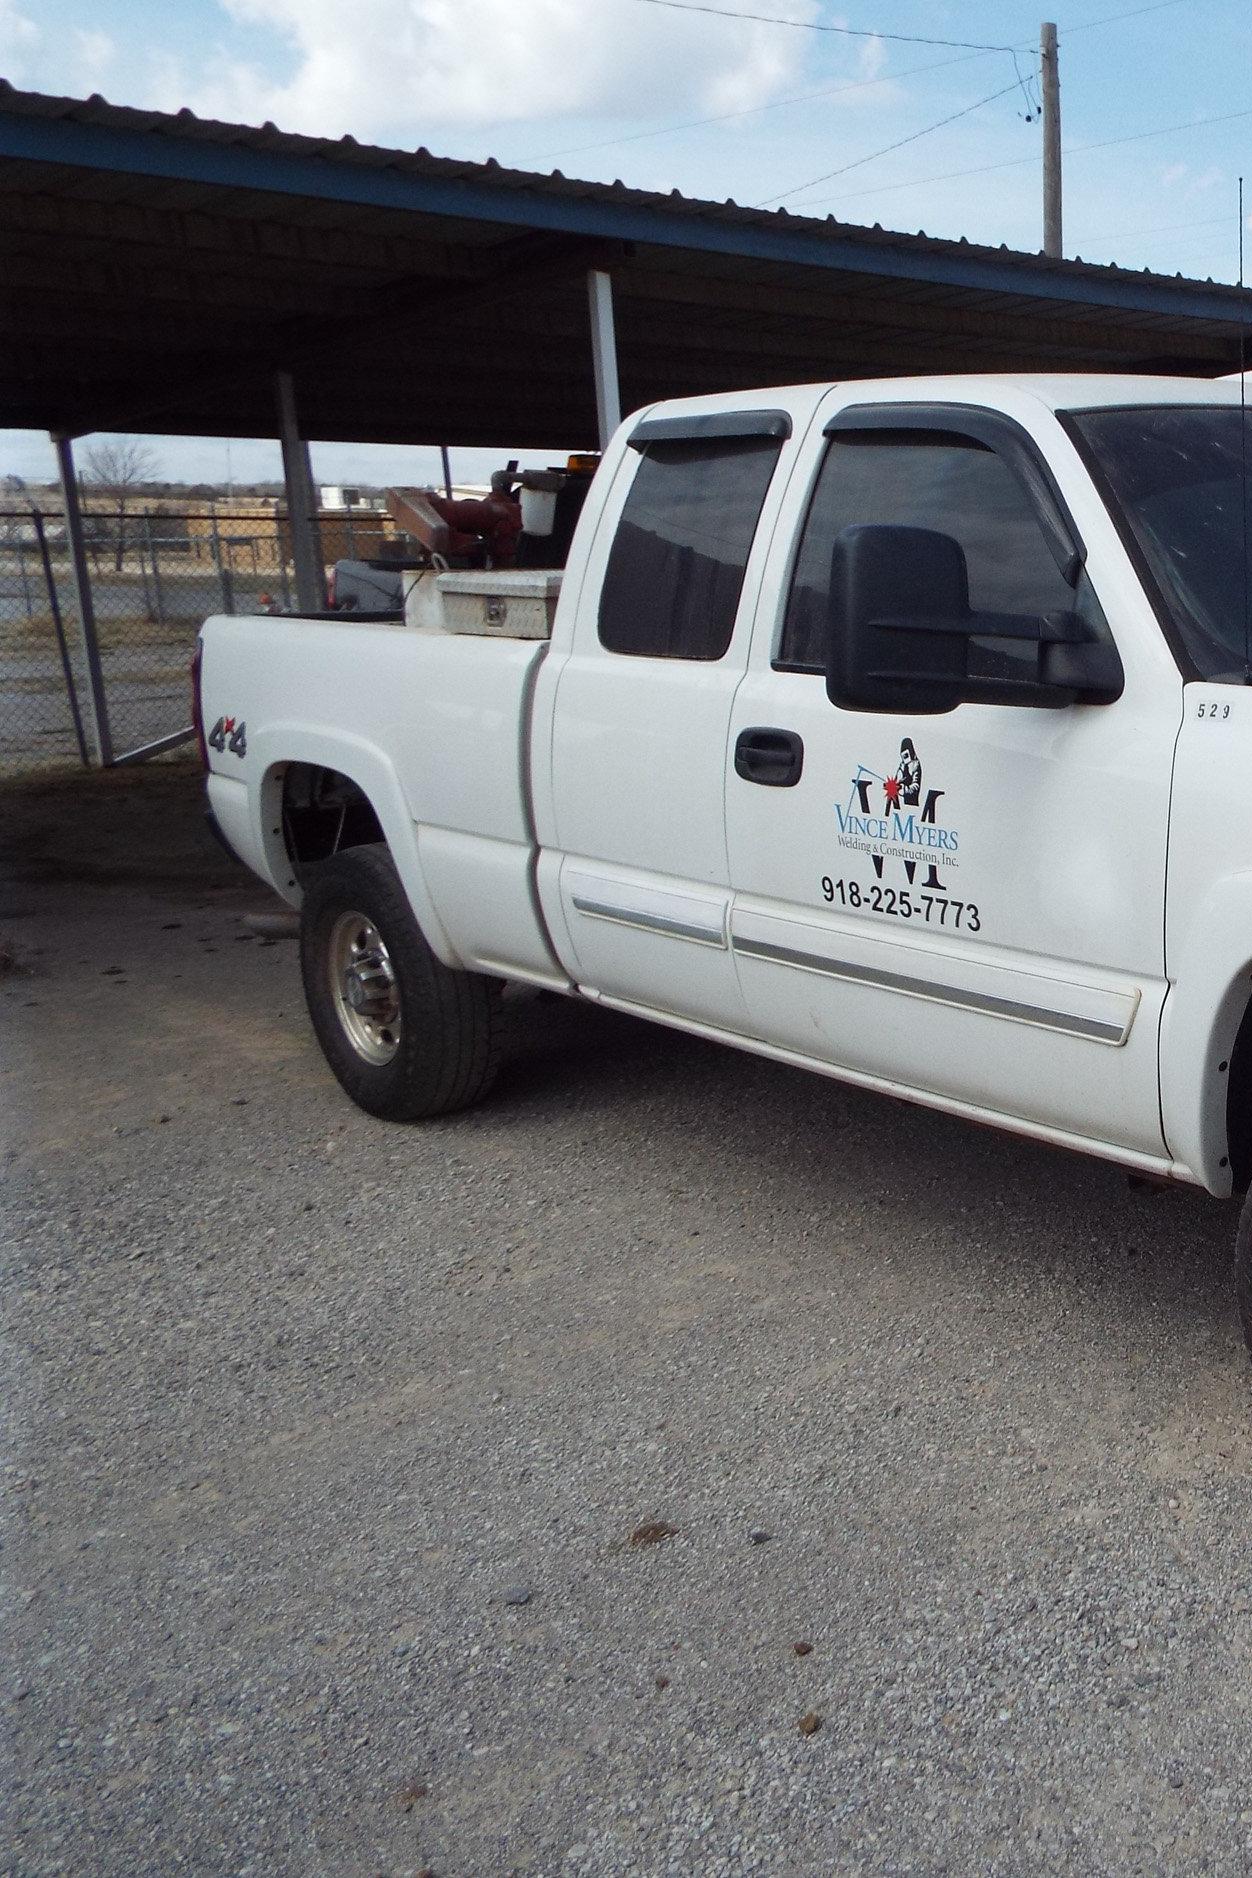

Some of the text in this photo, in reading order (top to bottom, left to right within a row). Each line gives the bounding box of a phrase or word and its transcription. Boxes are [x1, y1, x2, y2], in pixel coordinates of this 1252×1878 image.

[1198, 703, 1230, 719] 529
[834, 804, 959, 851] VINCE MYERS
[837, 835, 960, 867] Welding & Construction, Inc.
[821, 876, 981, 932] 918-225-7773
